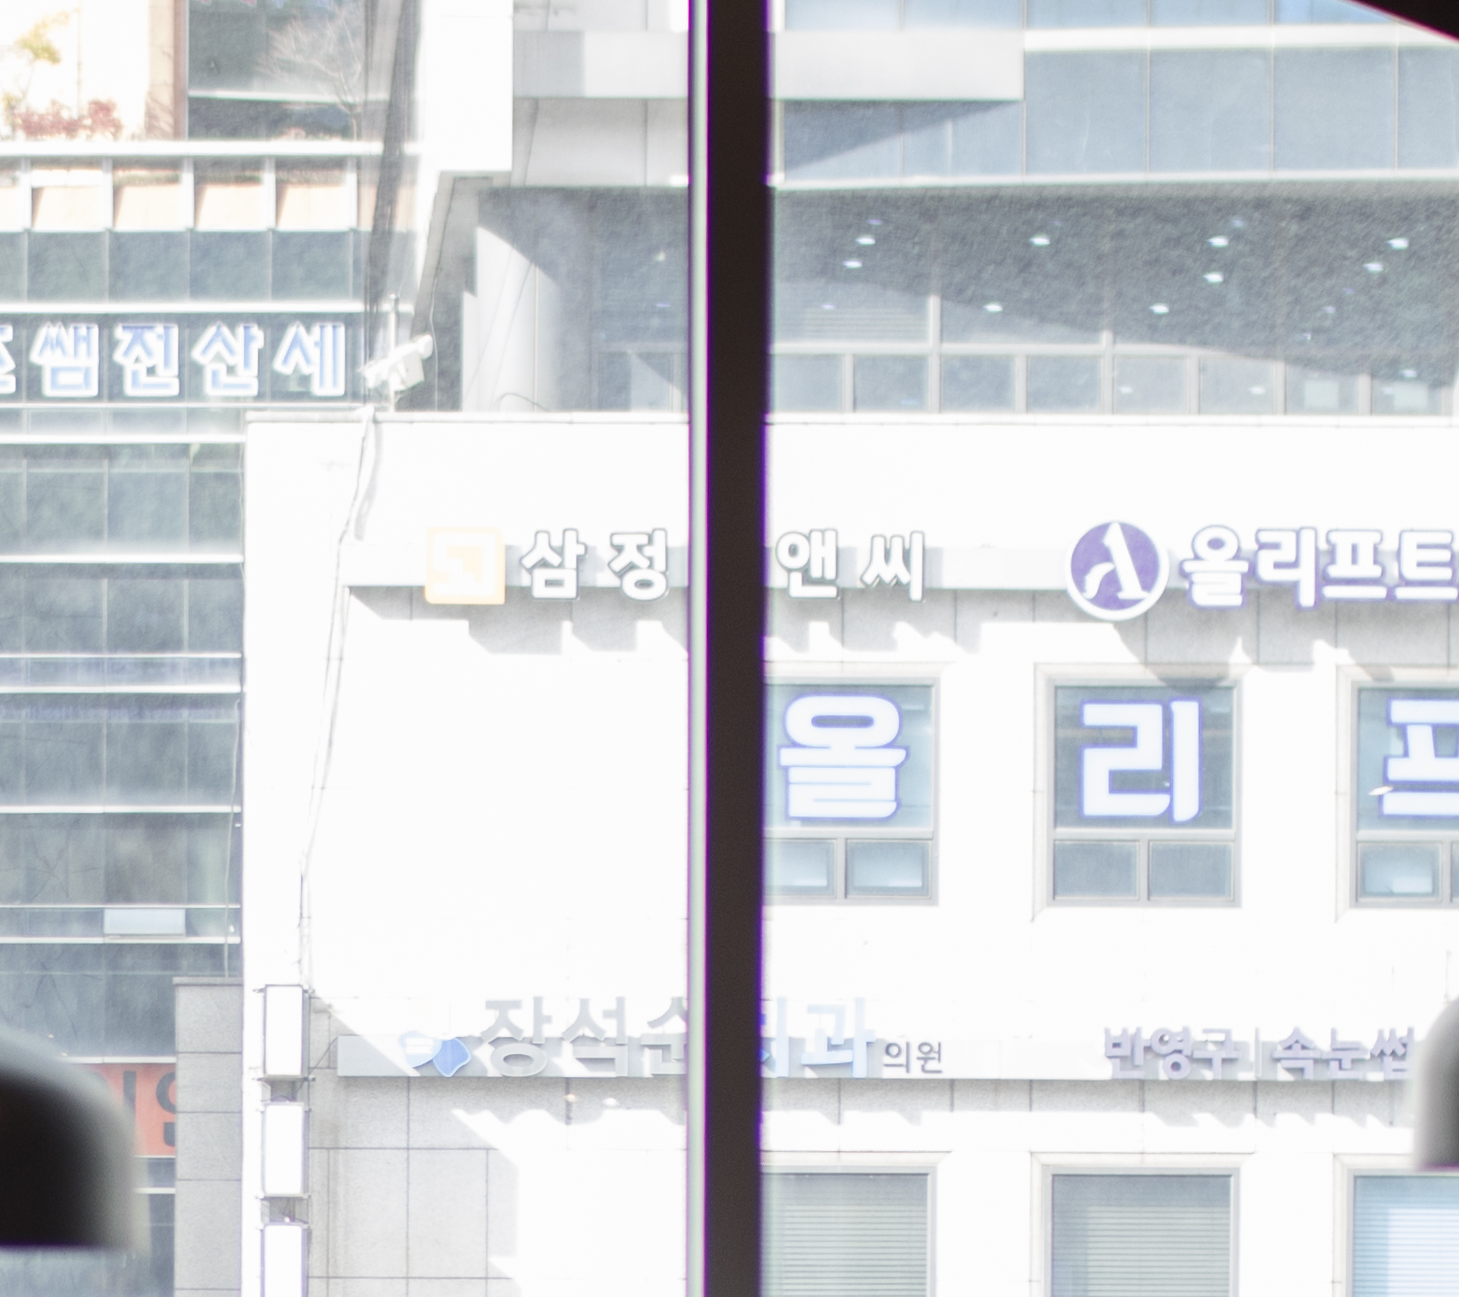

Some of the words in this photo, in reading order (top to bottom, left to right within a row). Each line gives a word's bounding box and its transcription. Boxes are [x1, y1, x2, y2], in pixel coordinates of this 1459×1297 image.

[882, 1040, 944, 1075] 의원
[1104, 1026, 1242, 1081] 반영구
[1271, 1026, 1415, 1081] 속눈썹
